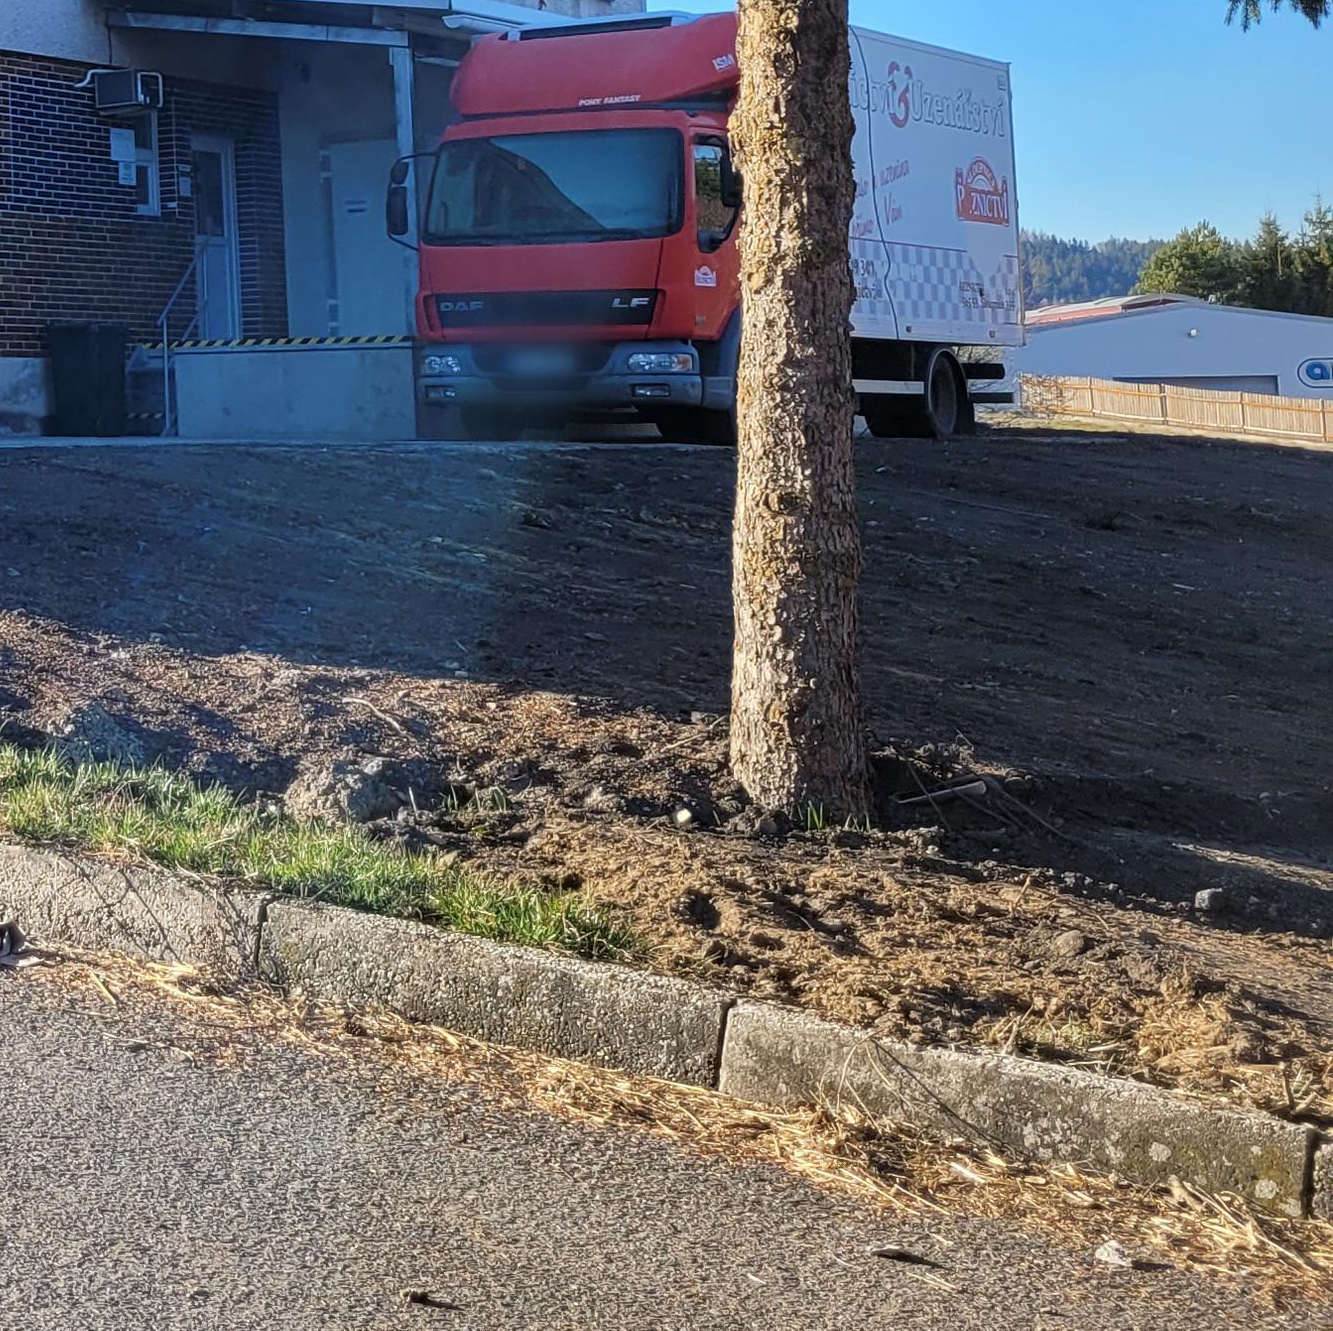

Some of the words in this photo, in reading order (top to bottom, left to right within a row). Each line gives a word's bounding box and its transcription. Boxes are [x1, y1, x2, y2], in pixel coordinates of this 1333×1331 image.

[603, 94, 641, 105] FANTASY
[909, 78, 1006, 138] Uzenářství
[440, 301, 484, 312] DAF
[611, 297, 650, 308] LF
[1306, 362, 1333, 380] a
